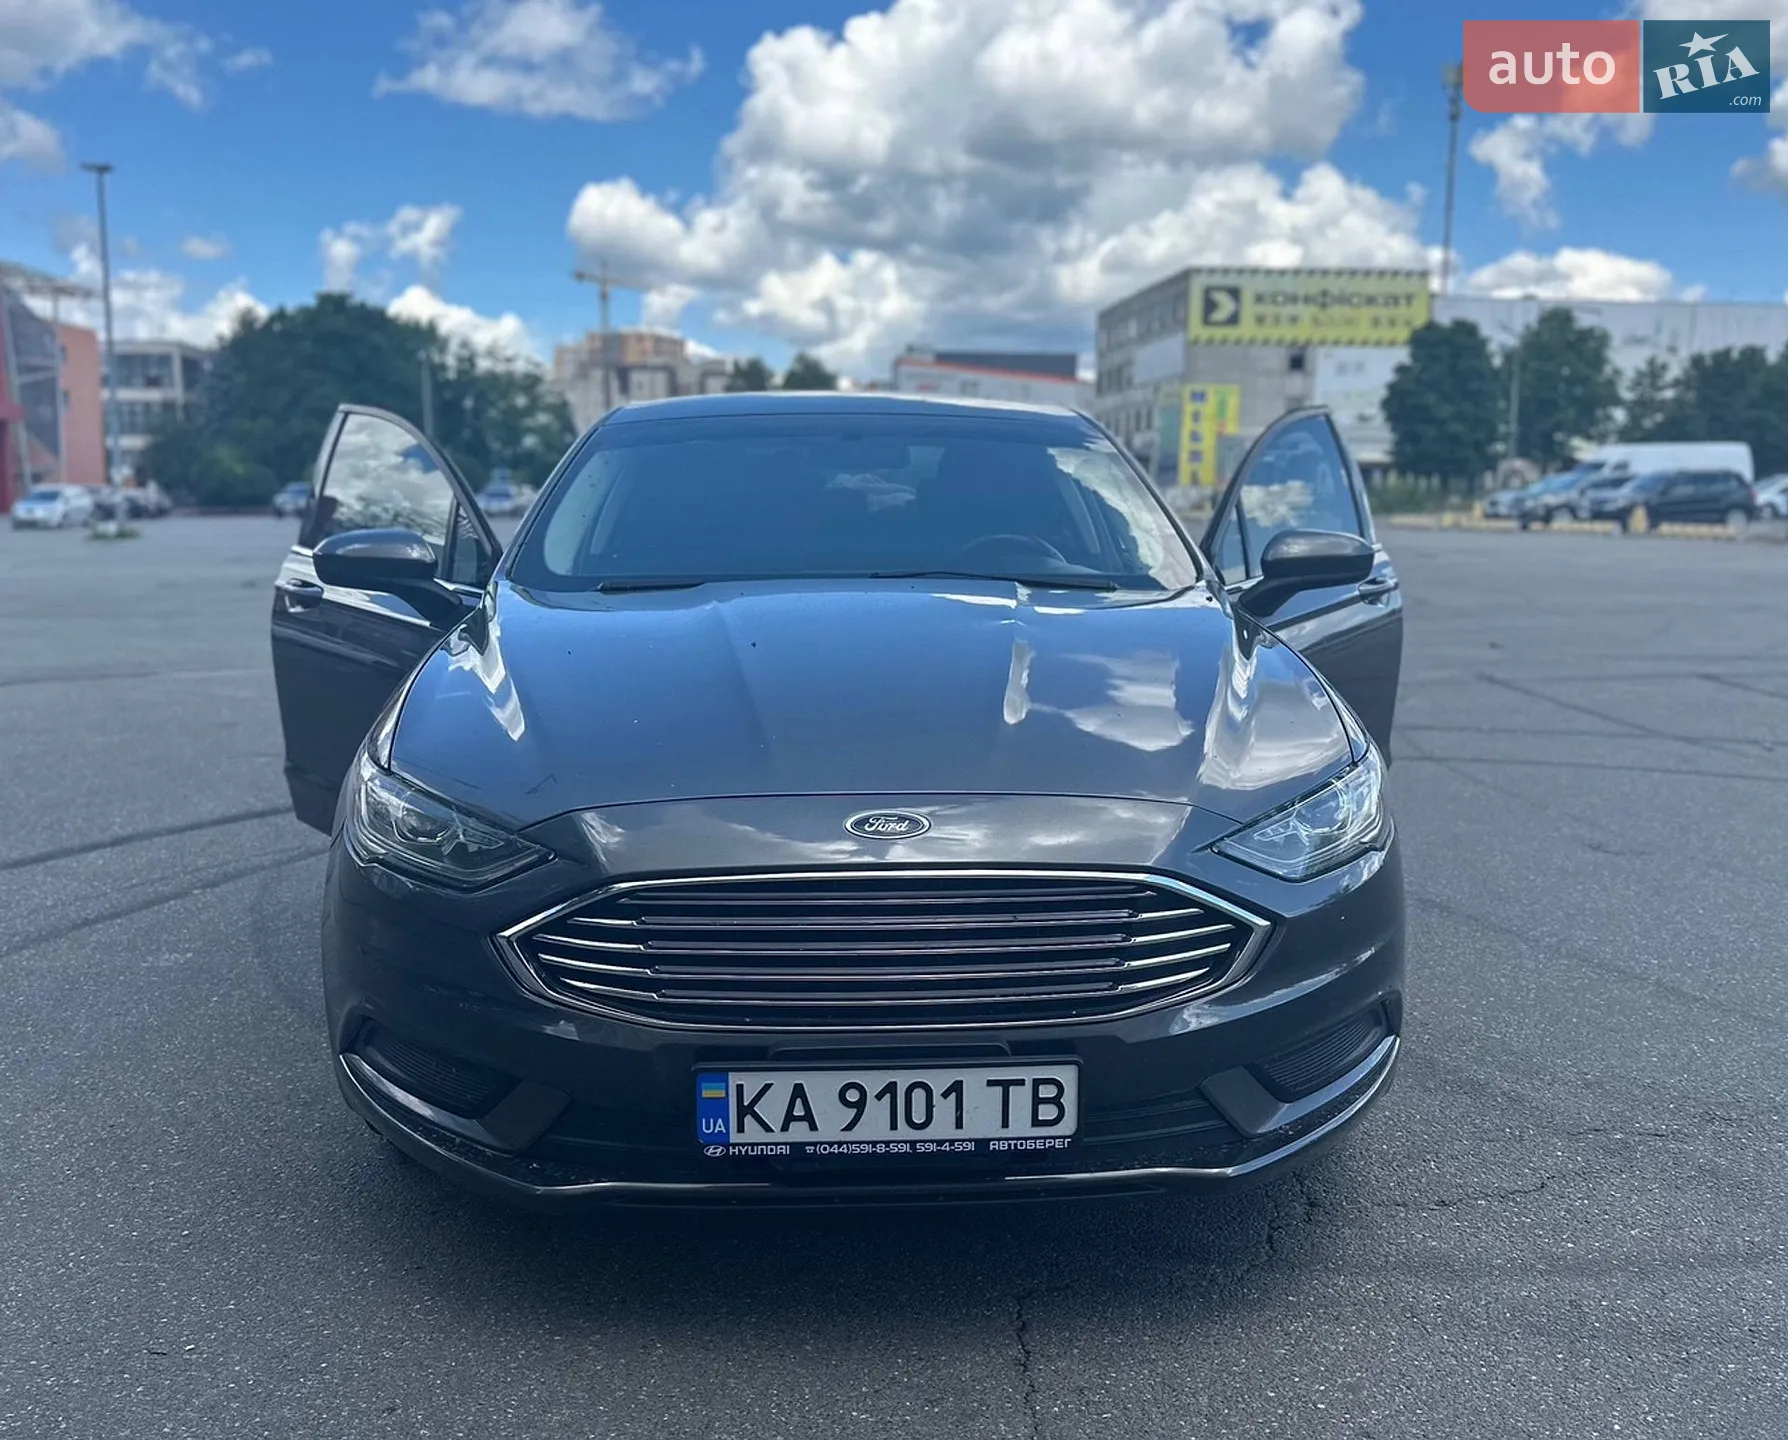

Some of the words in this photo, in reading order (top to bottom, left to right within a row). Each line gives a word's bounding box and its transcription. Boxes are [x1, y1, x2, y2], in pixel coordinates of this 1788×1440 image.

[864, 816, 909, 832] Ford
[734, 1081, 820, 1134] KA
[837, 1078, 965, 1132] 9101
[986, 1076, 1067, 1130] TB
[701, 1117, 726, 1134] UA
[729, 1144, 790, 1155] HYUNDAI
[916, 1141, 975, 1153] 591-4-591
[989, 1138, 1072, 1150] АВТОБЕРЕГ
